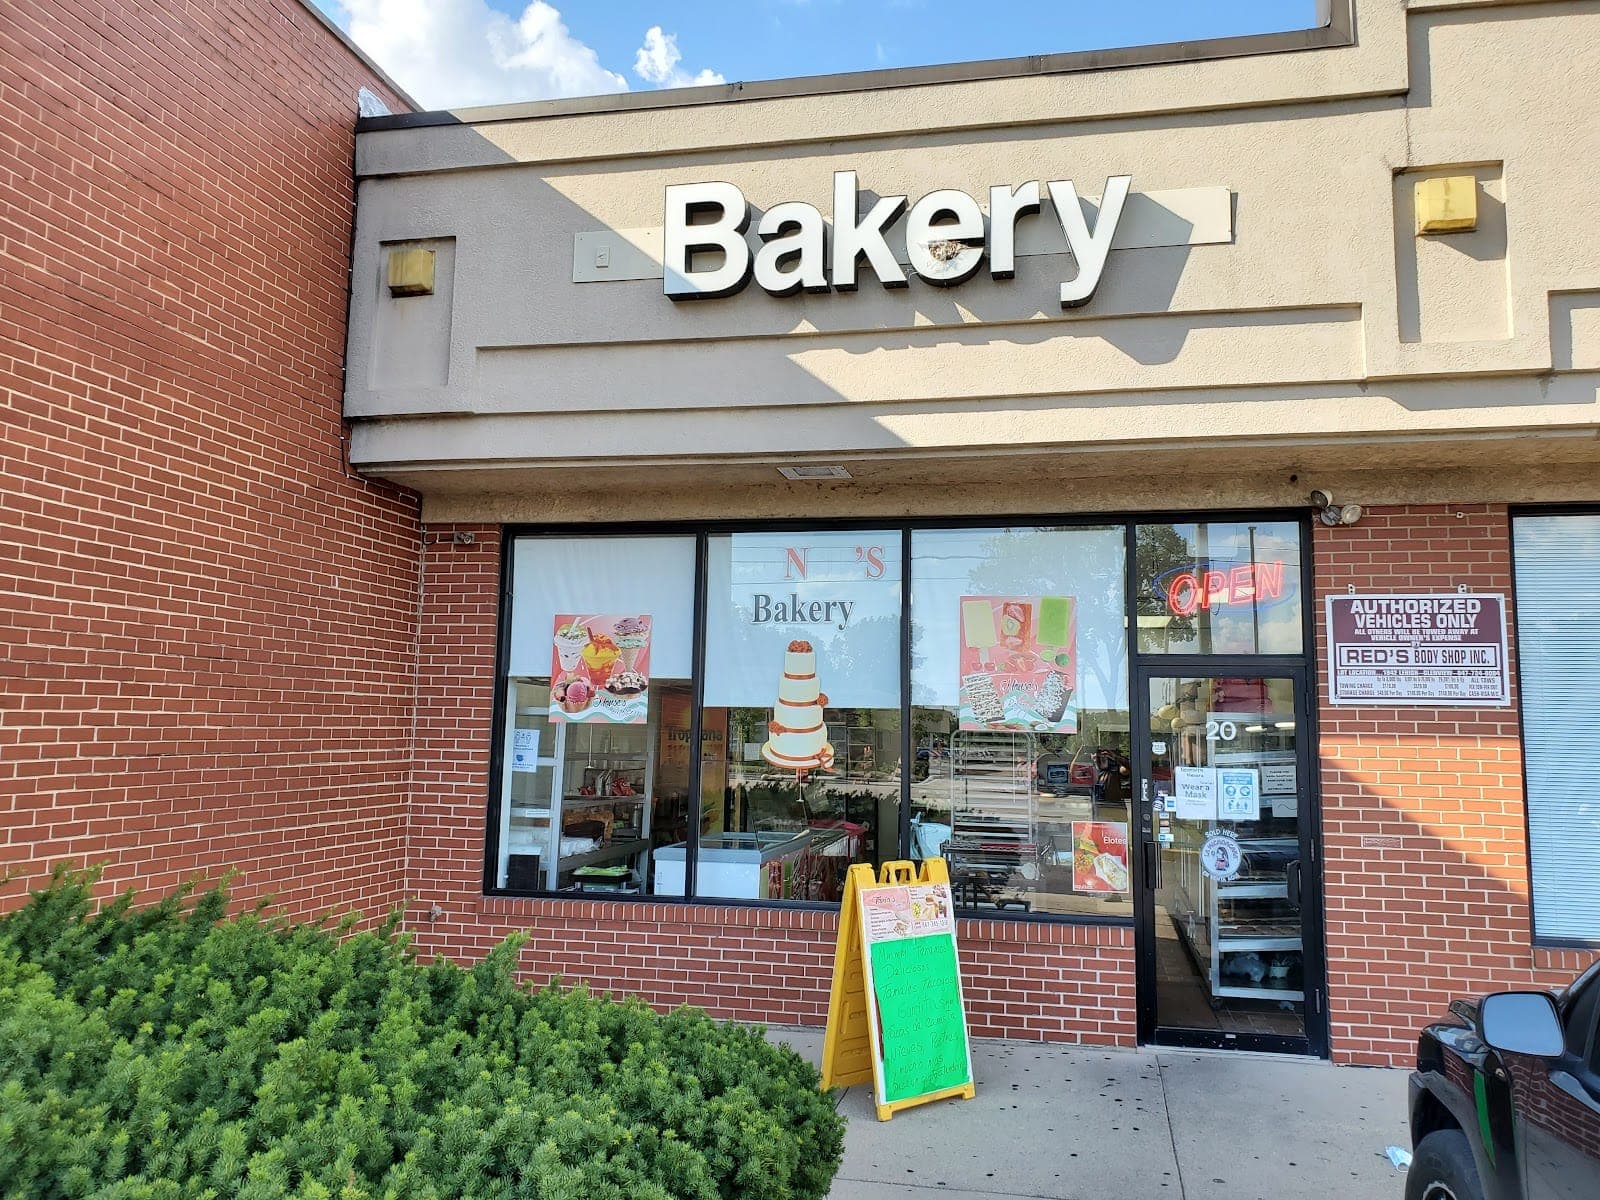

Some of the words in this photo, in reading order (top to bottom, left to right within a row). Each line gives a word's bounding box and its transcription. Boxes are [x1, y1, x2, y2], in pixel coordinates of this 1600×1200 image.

[664, 170, 1132, 307] Bakery
[784, 547, 809, 580] N
[1168, 560, 1284, 616] OPEN
[752, 592, 854, 631] Bakery
[1350, 599, 1481, 614] AUTHORIZED
[1354, 614, 1431, 628] VEHICLES
[1436, 614, 1477, 628] ONLY
[1346, 650, 1409, 663] RED'S
[1414, 650, 1438, 664] BODY
[1442, 650, 1466, 664] SHOP
[1470, 650, 1490, 664] INC.
[1205, 721, 1237, 741] 20
[1185, 791, 1208, 799] Mask
[1204, 829, 1220, 839] SOLD
